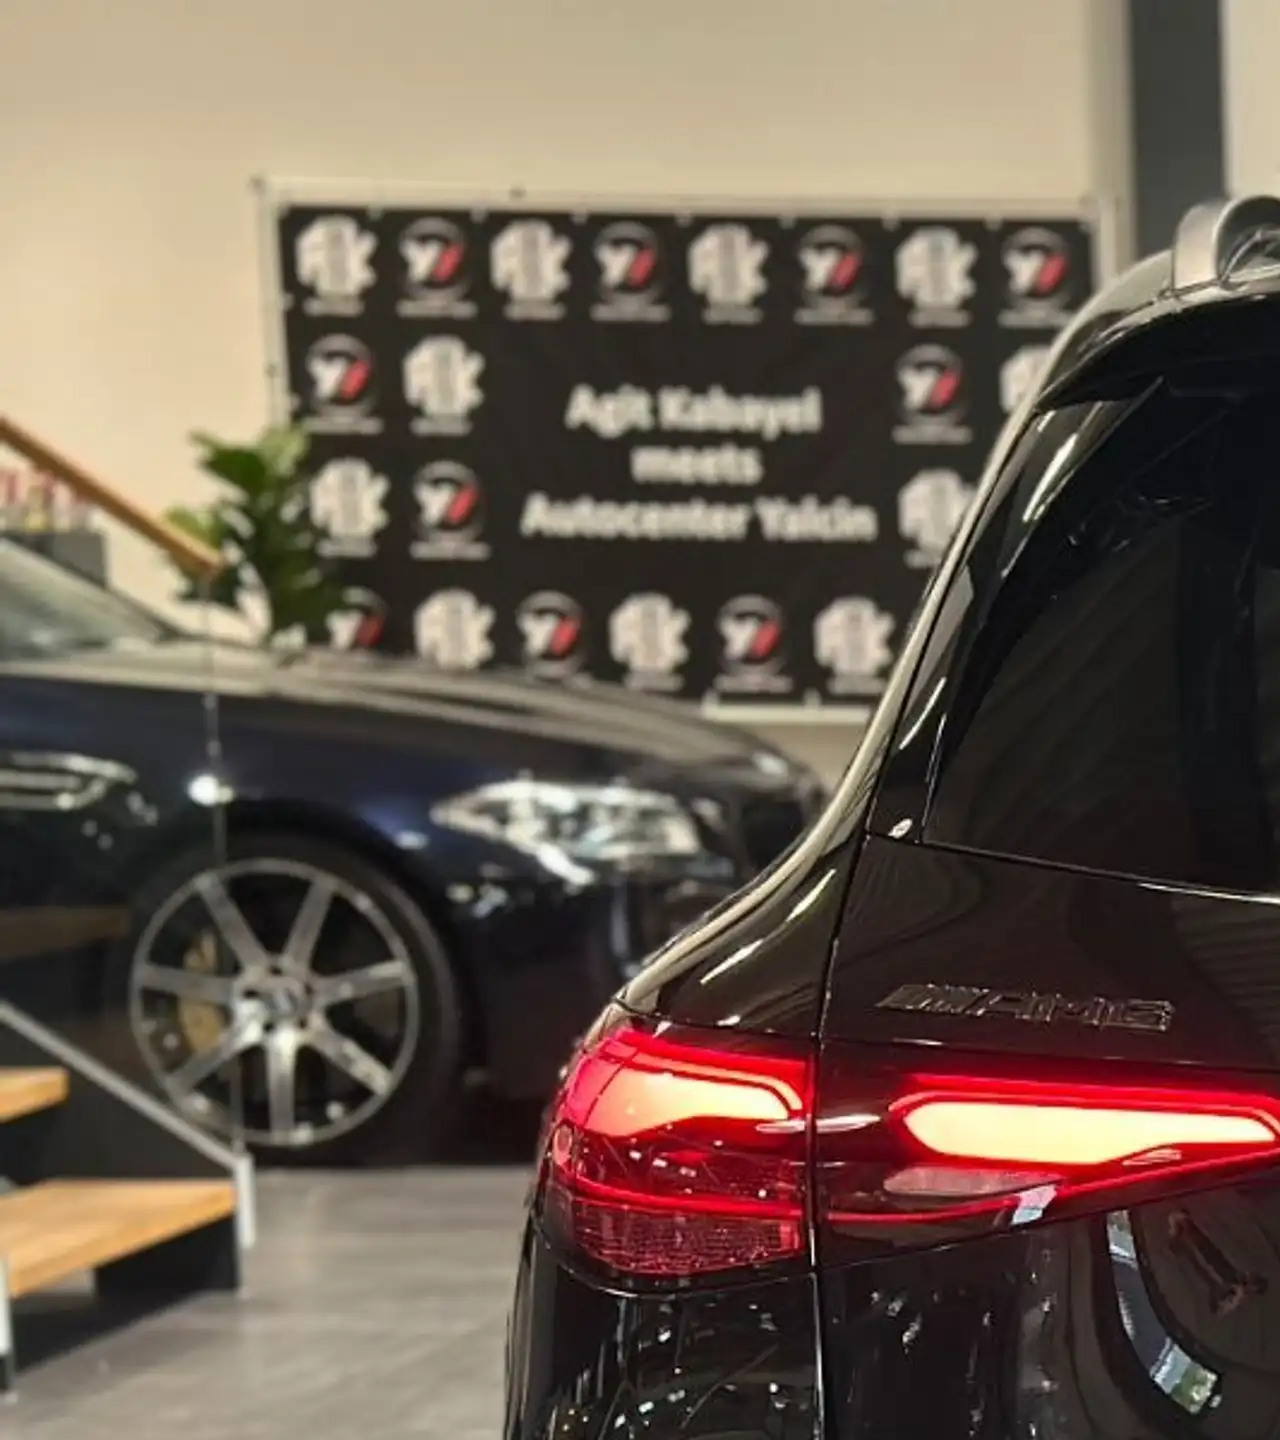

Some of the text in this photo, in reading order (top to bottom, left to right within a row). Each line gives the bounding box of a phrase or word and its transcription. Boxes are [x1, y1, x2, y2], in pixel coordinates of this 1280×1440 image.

[565, 384, 654, 438] Agit
[630, 442, 763, 485] meets
[519, 492, 750, 541] Autocenter
[752, 495, 878, 542] Yalcin
